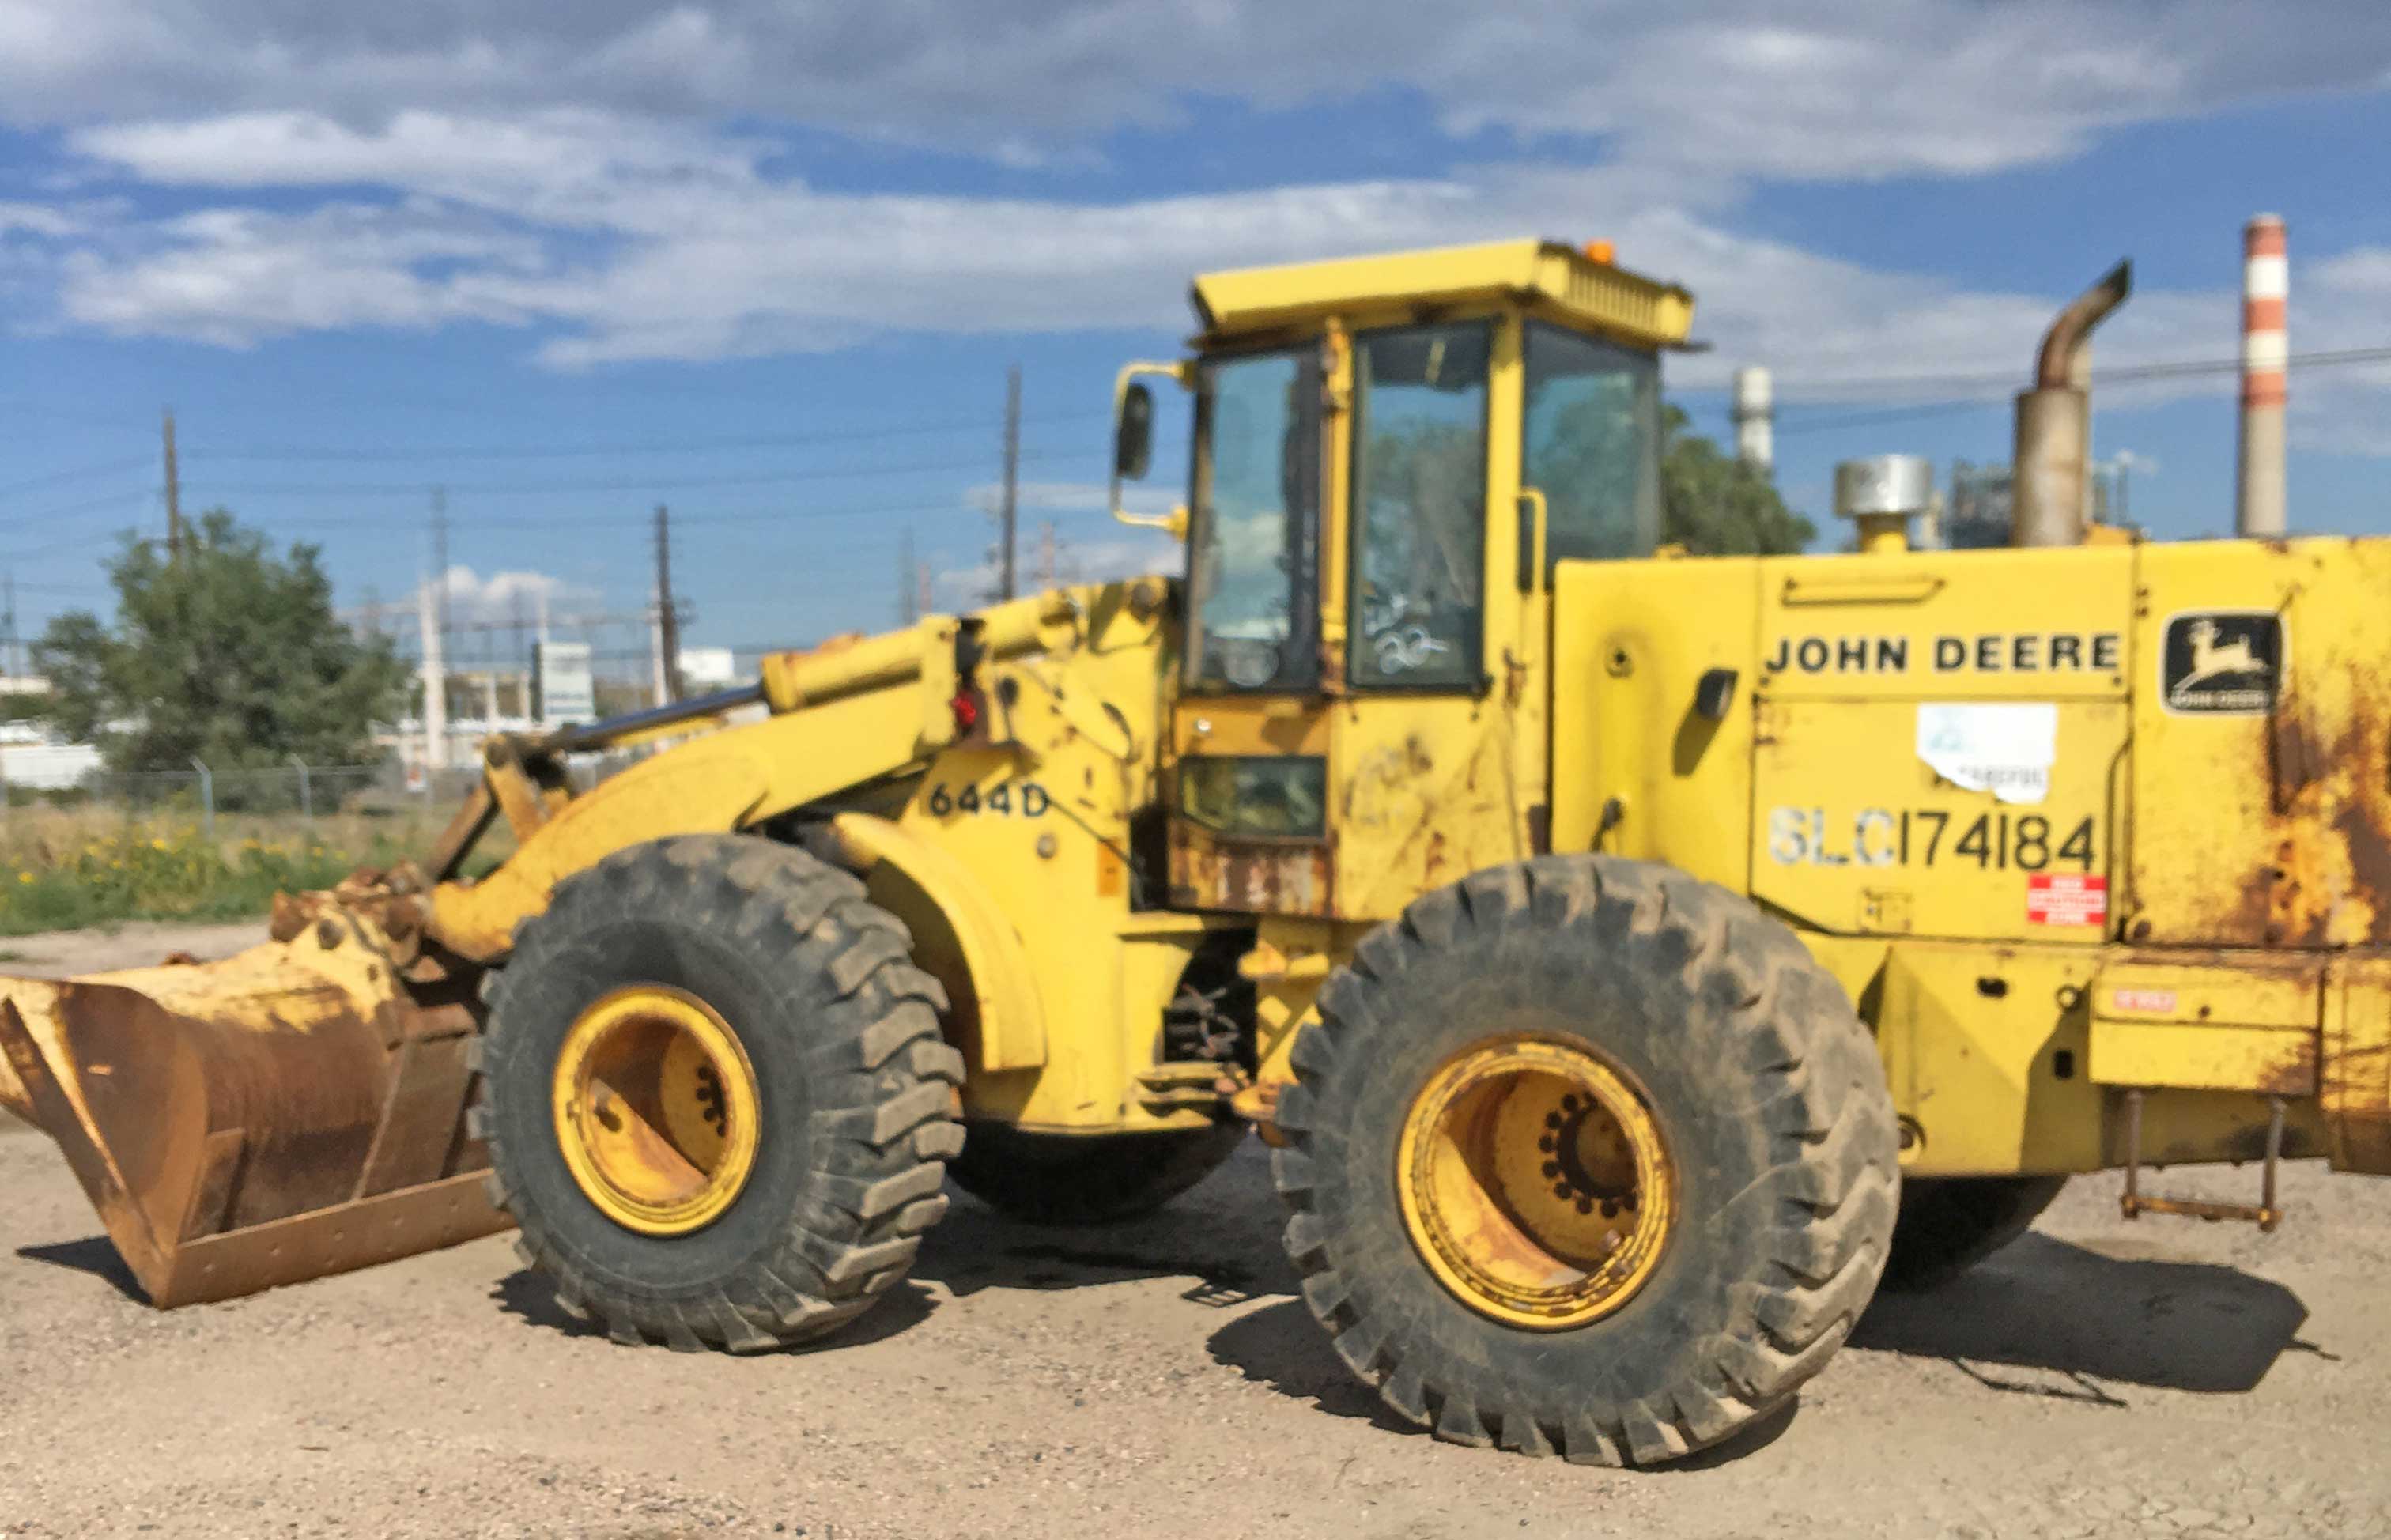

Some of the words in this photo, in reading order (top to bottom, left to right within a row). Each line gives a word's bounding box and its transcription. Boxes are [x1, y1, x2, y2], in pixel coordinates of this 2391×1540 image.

[1766, 636, 1907, 672] JOHN
[1936, 634, 2120, 671] DEERE
[930, 783, 1050, 817] 644D
